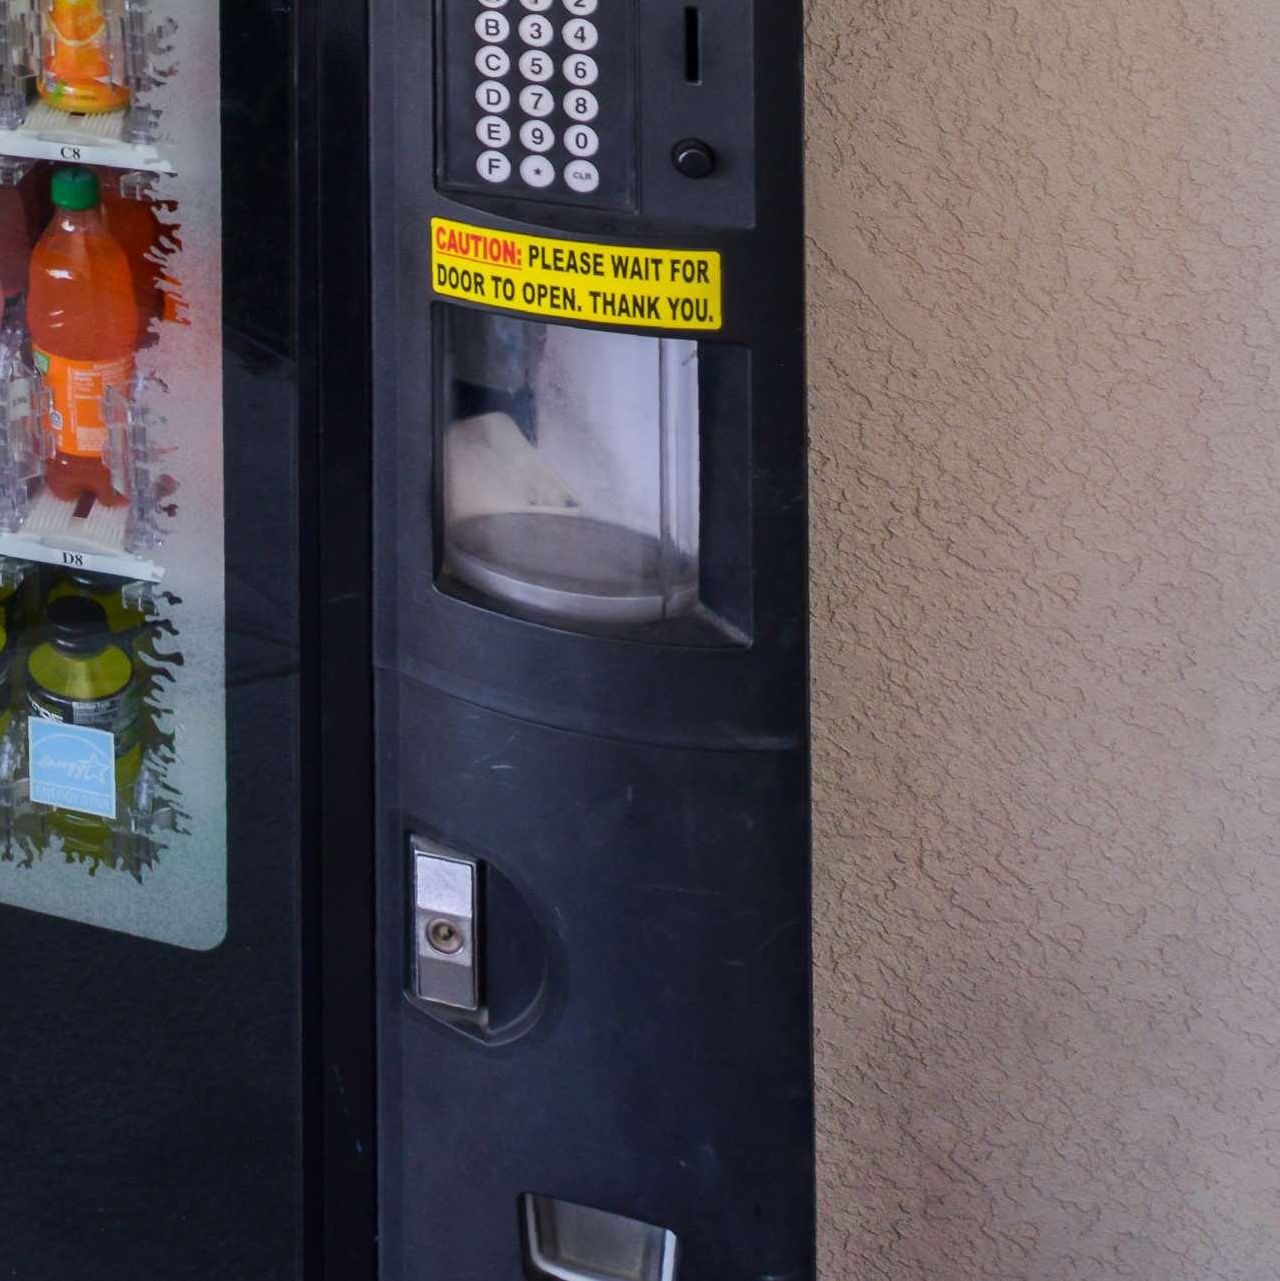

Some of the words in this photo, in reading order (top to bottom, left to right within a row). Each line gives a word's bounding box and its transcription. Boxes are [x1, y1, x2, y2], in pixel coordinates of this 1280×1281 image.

[485, 19, 501, 36] B
[529, 22, 542, 40] 3
[573, 26, 587, 44] 4
[485, 53, 502, 71] C
[530, 58, 543, 75] 5
[574, 61, 587, 79] 6
[486, 89, 502, 106] D
[530, 93, 543, 110] 7
[575, 96, 588, 114] 8
[487, 123, 501, 141] E
[531, 127, 545, 145] 9
[575, 131, 589, 149] 0
[60, 146, 81, 160] C8
[487, 158, 501, 175] F
[572, 171, 592, 180] CLR
[436, 226, 522, 266] CAUTION:
[528, 244, 605, 277] PLEASE
[611, 254, 665, 282] WAIT
[670, 259, 710, 284] FOR
[436, 263, 486, 296] DOOR
[491, 276, 516, 302] TO
[522, 281, 582, 312] OPEN.
[589, 291, 661, 320] THANK
[667, 297, 714, 323] YOU.
[62, 552, 83, 566] D8
